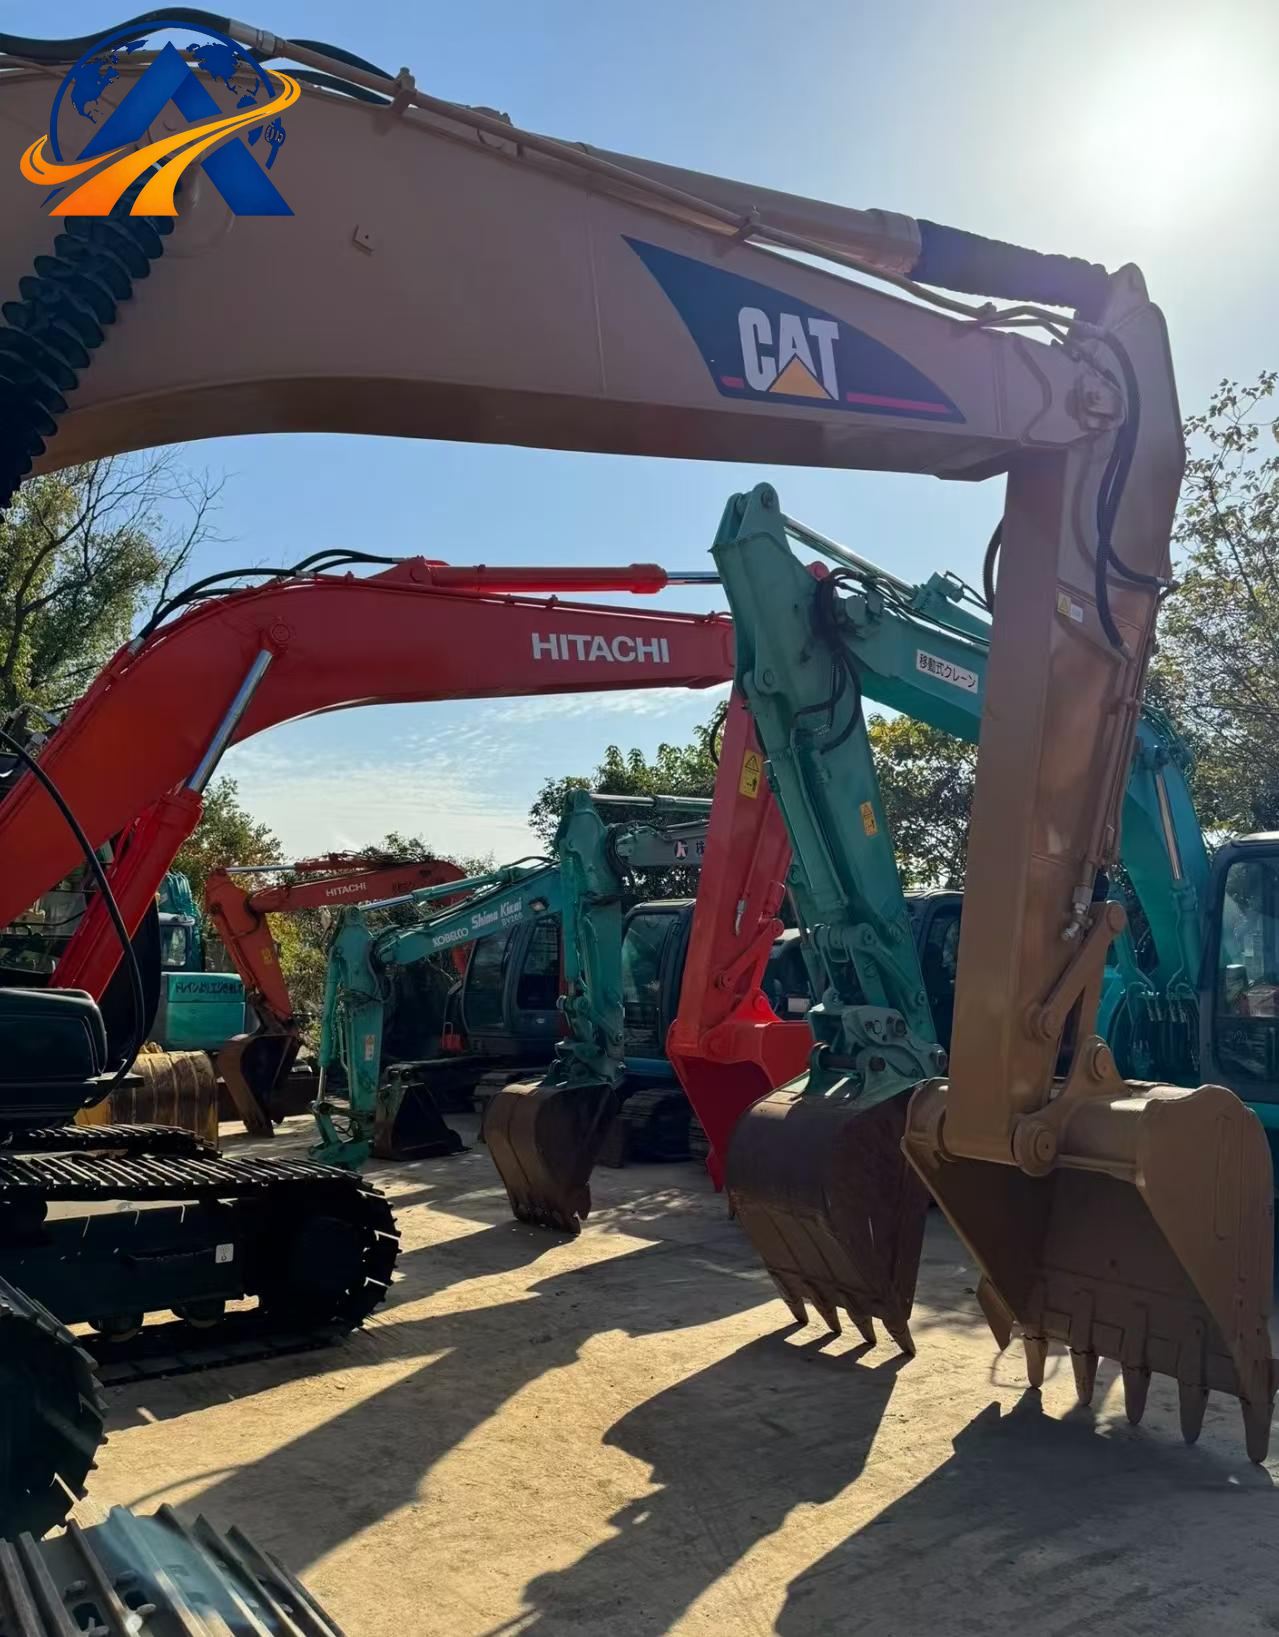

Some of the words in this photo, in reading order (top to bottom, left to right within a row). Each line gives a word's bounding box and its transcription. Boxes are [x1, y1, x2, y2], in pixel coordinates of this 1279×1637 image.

[738, 306, 839, 401] CAT
[531, 632, 670, 663] HITACHI
[919, 653, 977, 688] 移動式クレーン
[325, 882, 367, 897] HITACHI
[432, 928, 469, 948] KOBELCO
